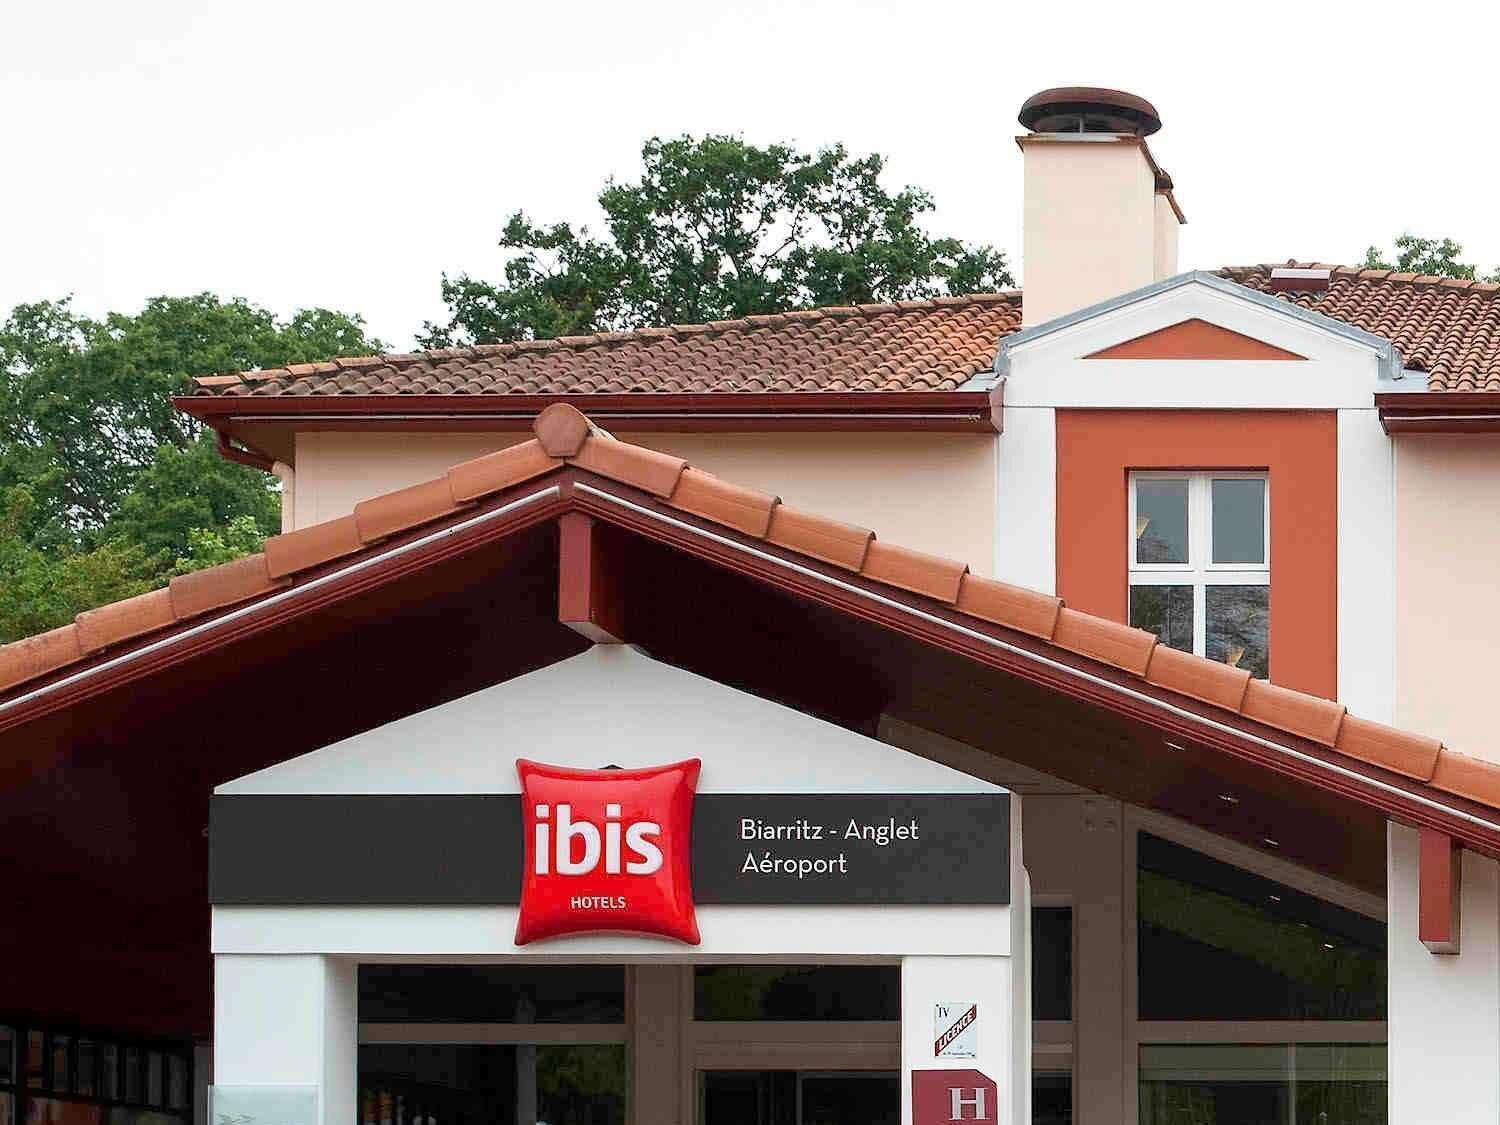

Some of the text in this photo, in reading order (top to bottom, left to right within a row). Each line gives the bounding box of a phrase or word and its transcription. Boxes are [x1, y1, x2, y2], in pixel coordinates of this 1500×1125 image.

[534, 803, 665, 876] ibis
[741, 818, 823, 841] Biarritz
[844, 818, 920, 846] Anglet
[741, 851, 848, 880] Aéroport
[570, 896, 627, 911] HOTELS
[938, 1010, 975, 1052] LICENCE
[947, 1086, 991, 1121] H
